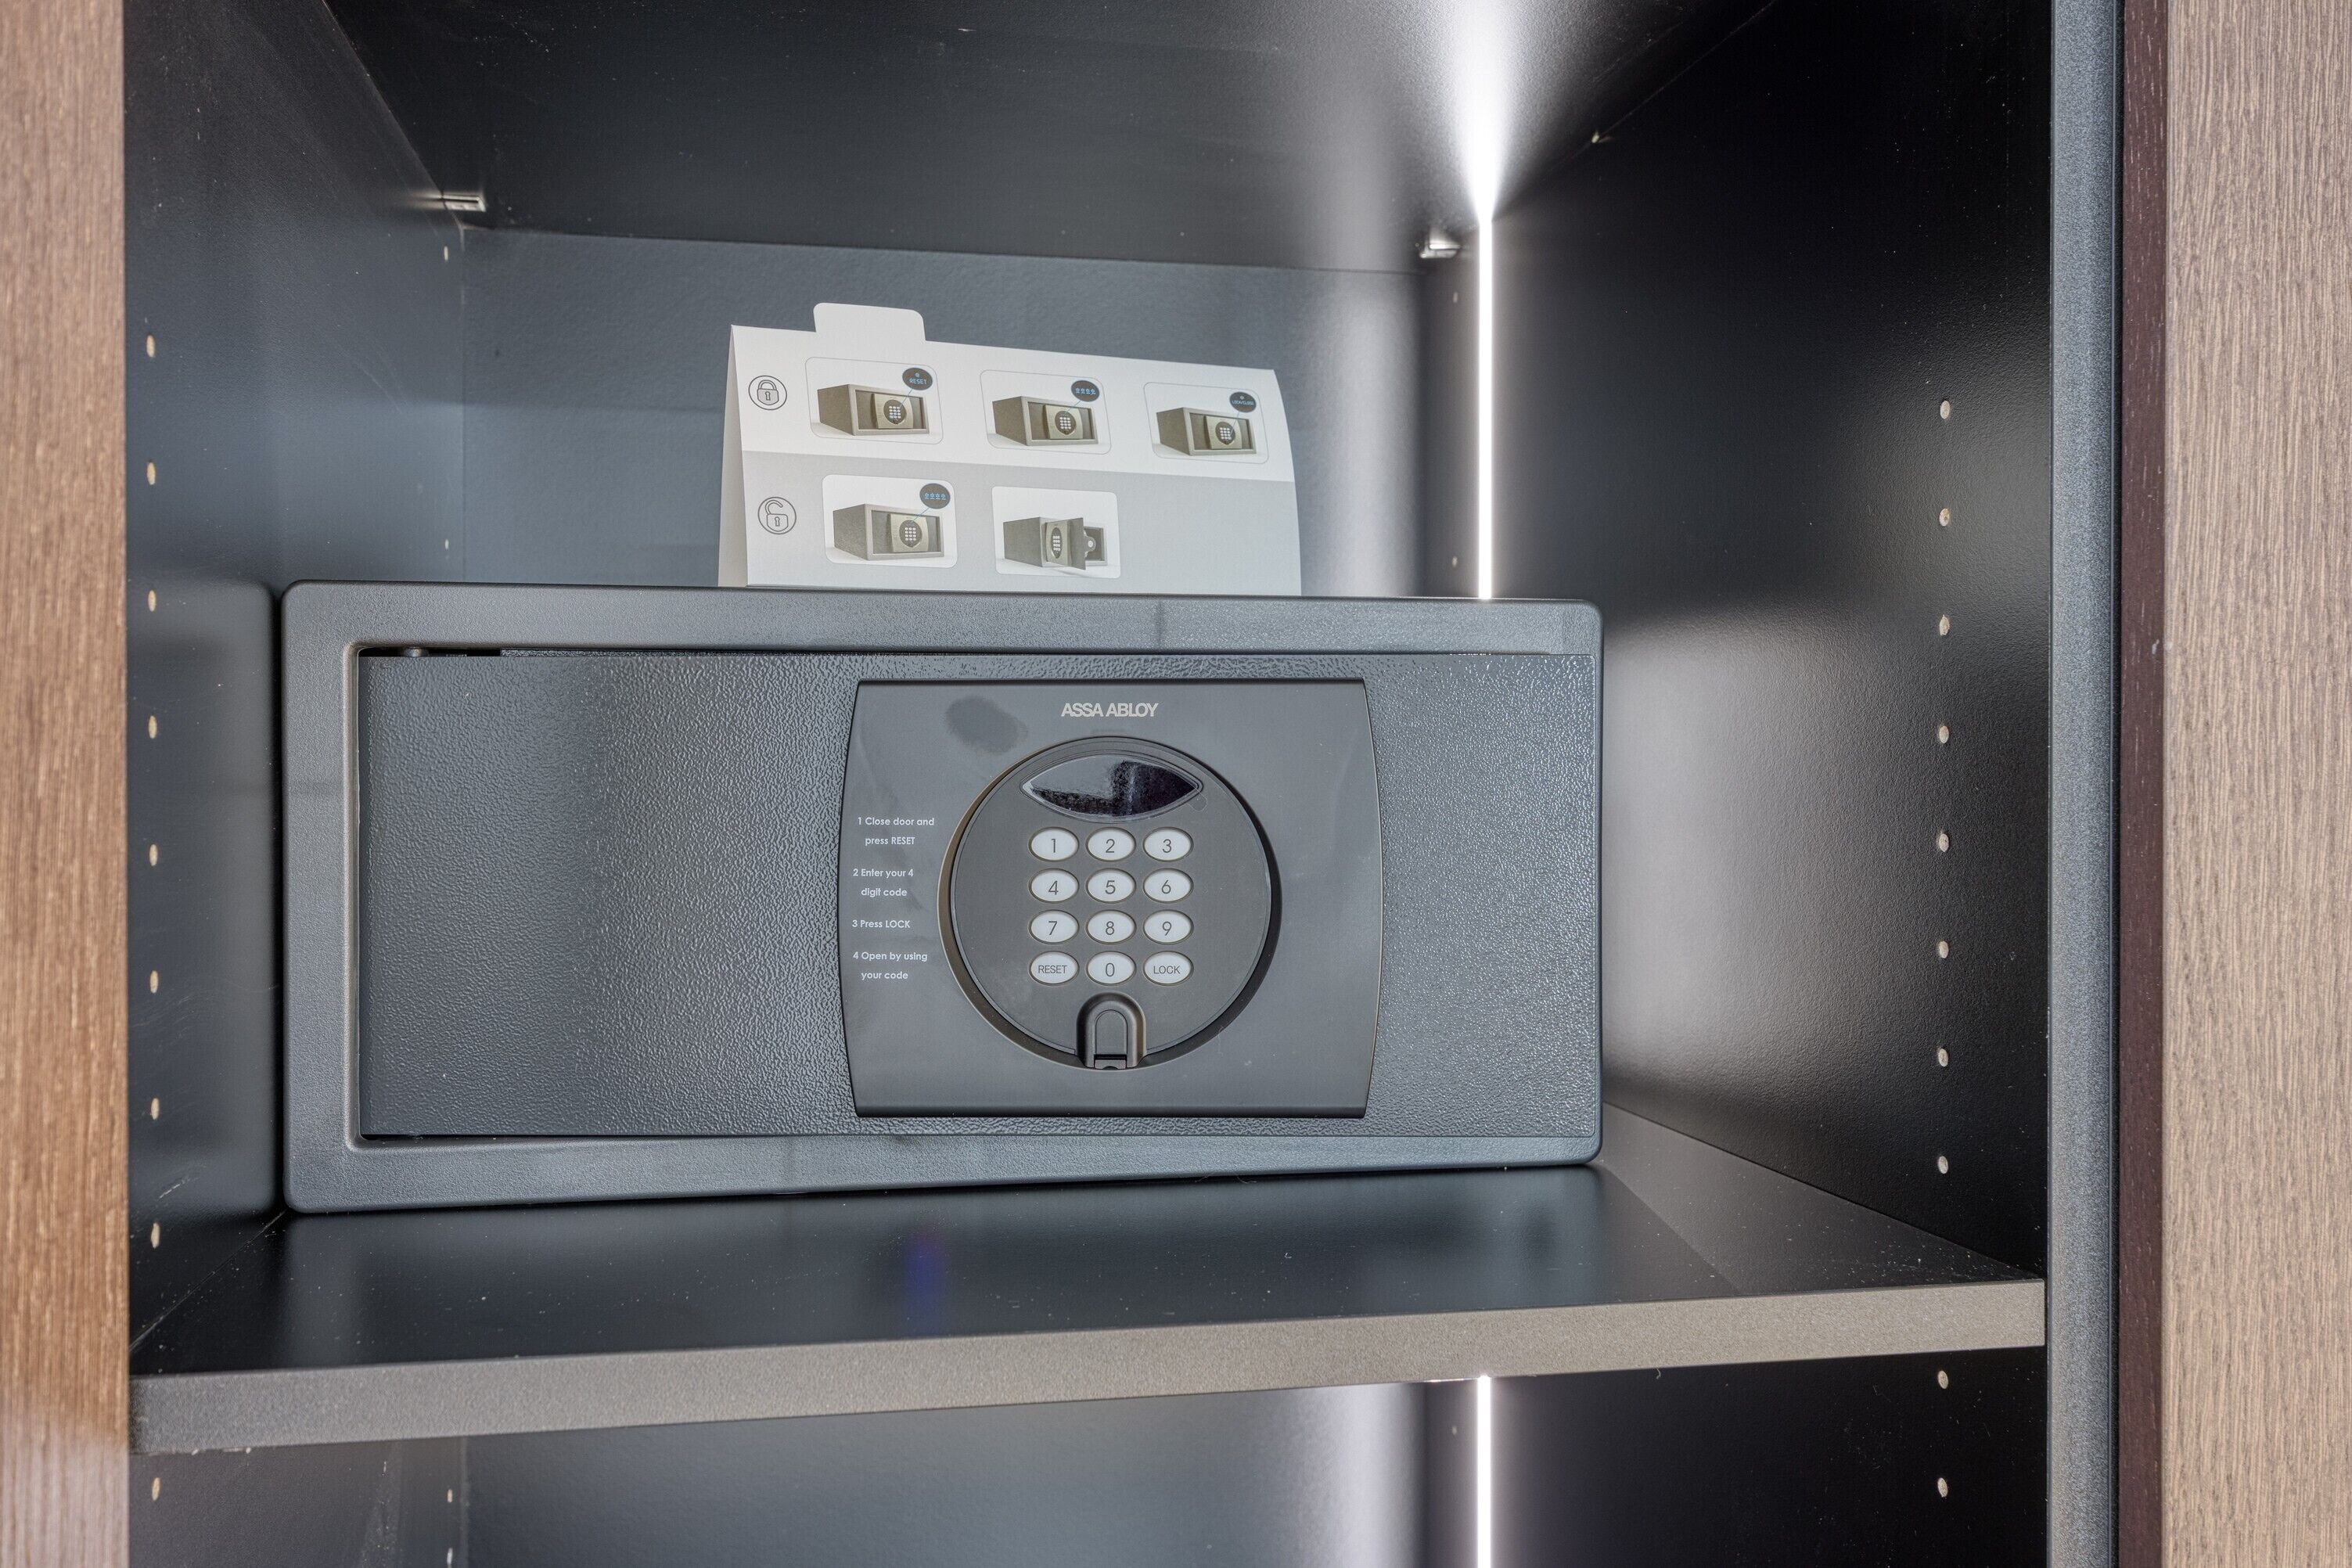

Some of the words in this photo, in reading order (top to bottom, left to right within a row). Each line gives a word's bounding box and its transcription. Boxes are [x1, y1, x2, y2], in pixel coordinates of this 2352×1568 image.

[1061, 702, 1104, 717] ASSA
[1106, 702, 1159, 717] ABLOY
[858, 817, 861, 825] 1
[865, 817, 890, 825] Close
[893, 817, 915, 825] door
[916, 818, 935, 826] and
[865, 837, 889, 846] press
[891, 836, 915, 845] RESET
[1051, 838, 1056, 854] 1
[1105, 838, 1115, 854] 2
[1162, 838, 1172, 854] 3
[853, 868, 858, 876] 2
[861, 869, 883, 877] Enter
[886, 870, 906, 879] your
[908, 869, 914, 877] 4
[861, 887, 881, 897] digit
[883, 888, 908, 897] code
[1048, 880, 1059, 895] 4
[1105, 880, 1116, 895] 5
[1161, 879, 1171, 894] 6
[852, 919, 858, 928] 3
[860, 919, 883, 928] Press
[885, 919, 911, 929] LOCK
[1048, 920, 1058, 936] 7
[1105, 920, 1115, 936] 8
[1162, 921, 1172, 936] 9
[853, 951, 859, 960] 4
[861, 951, 887, 961] Open
[890, 951, 901, 962] by
[904, 952, 928, 962] using
[1038, 965, 1068, 974] RESET
[1105, 962, 1115, 976] 0
[1153, 965, 1181, 974] LOCK
[861, 972, 882, 980] your
[884, 971, 908, 980] code
